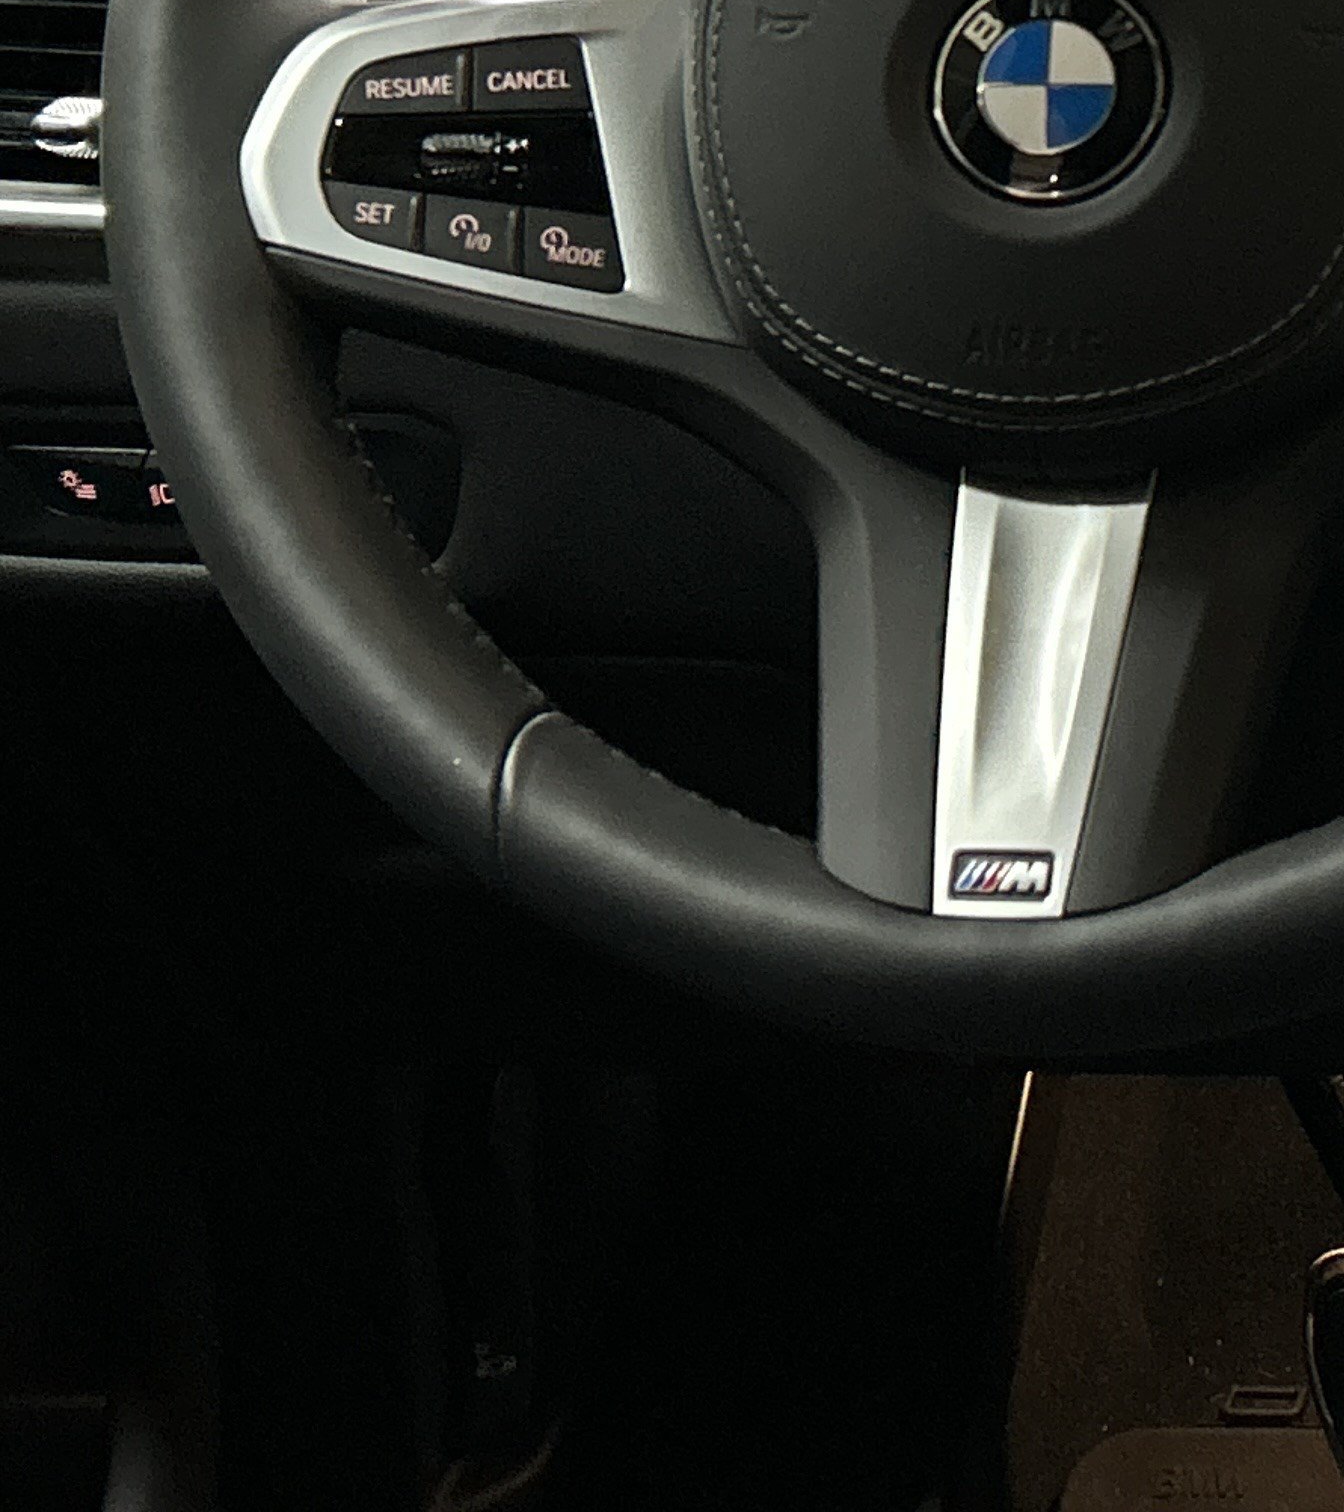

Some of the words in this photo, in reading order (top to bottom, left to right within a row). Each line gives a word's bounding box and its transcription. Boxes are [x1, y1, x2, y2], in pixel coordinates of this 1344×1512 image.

[365, 74, 454, 99] RESUME
[487, 68, 571, 93] CANCEL
[354, 201, 395, 225] SET
[548, 247, 606, 269] MODE
